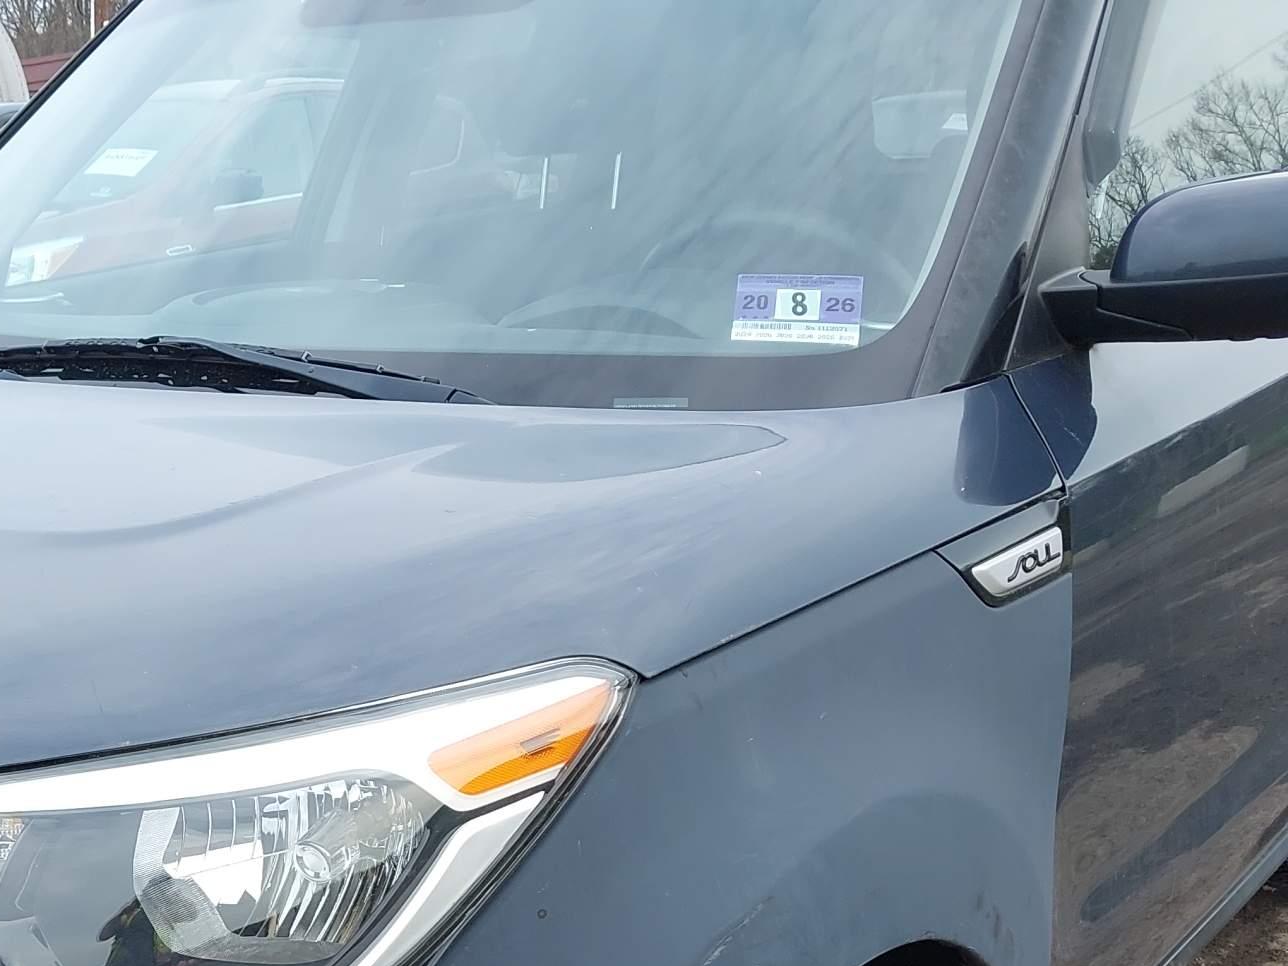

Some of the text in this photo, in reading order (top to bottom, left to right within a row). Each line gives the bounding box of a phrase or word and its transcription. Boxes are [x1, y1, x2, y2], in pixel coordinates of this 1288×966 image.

[742, 292, 856, 316] 20 8 26
